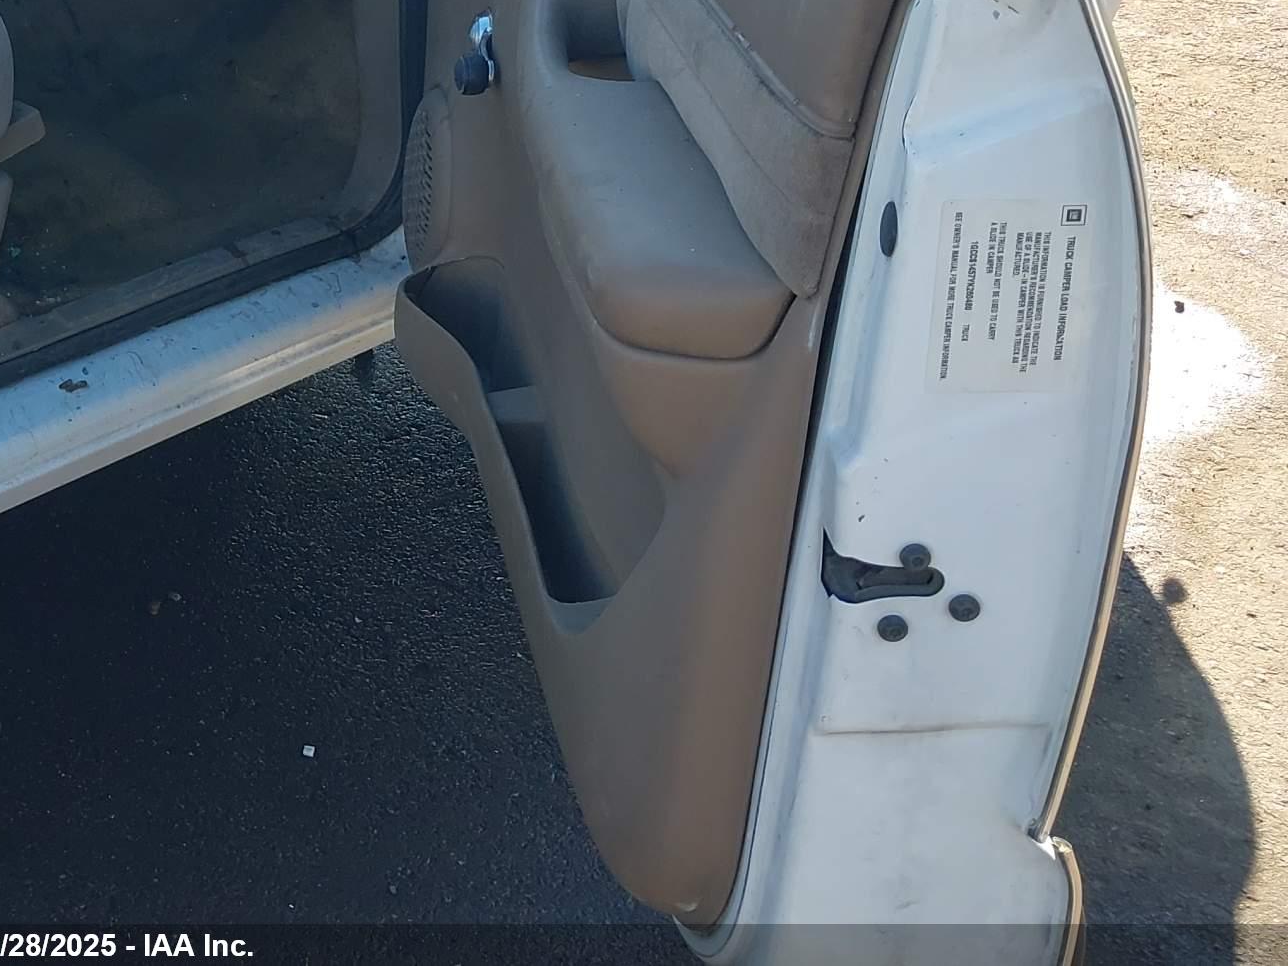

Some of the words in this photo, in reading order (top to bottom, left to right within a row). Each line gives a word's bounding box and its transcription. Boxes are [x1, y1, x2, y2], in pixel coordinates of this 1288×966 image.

[952, 224, 962, 249] OWNER'S
[989, 227, 997, 242] SLIDE
[1043, 232, 1051, 244] THIS
[997, 237, 1005, 254] TRUCK
[1066, 236, 1076, 260] TRUCK
[950, 250, 959, 272] MANUAL
[986, 252, 995, 274] CAMPER
[1030, 232, 1042, 280] MANUFACTURER'S
[1040, 245, 1050, 282] INFORMATION
[995, 255, 1004, 277] SHOULD
[949, 274, 957, 285] FOR
[1062, 262, 1072, 291] CAMPER
[947, 286, 956, 301] MORE
[1018, 286, 1027, 307] CAMPER
[1060, 294, 1069, 311] LOAD
[945, 303, 954, 319] TRUCK
[991, 299, 999, 313] USED
[1024, 282, 1036, 331] RECOMMENDATION
[1034, 291, 1044, 321] FURNISHED
[1016, 310, 1024, 323] WITH
[943, 321, 952, 342] CAMPER
[962, 324, 970, 342] TRUCK
[988, 323, 997, 340] CARRY
[1015, 325, 1023, 336] THIS
[1013, 339, 1021, 355] TRUCK
[1021, 332, 1030, 362] REGARDING
[1031, 331, 1040, 354] INDICATE
[1019, 363, 1027, 372] THE
[1029, 356, 1037, 365] THE
